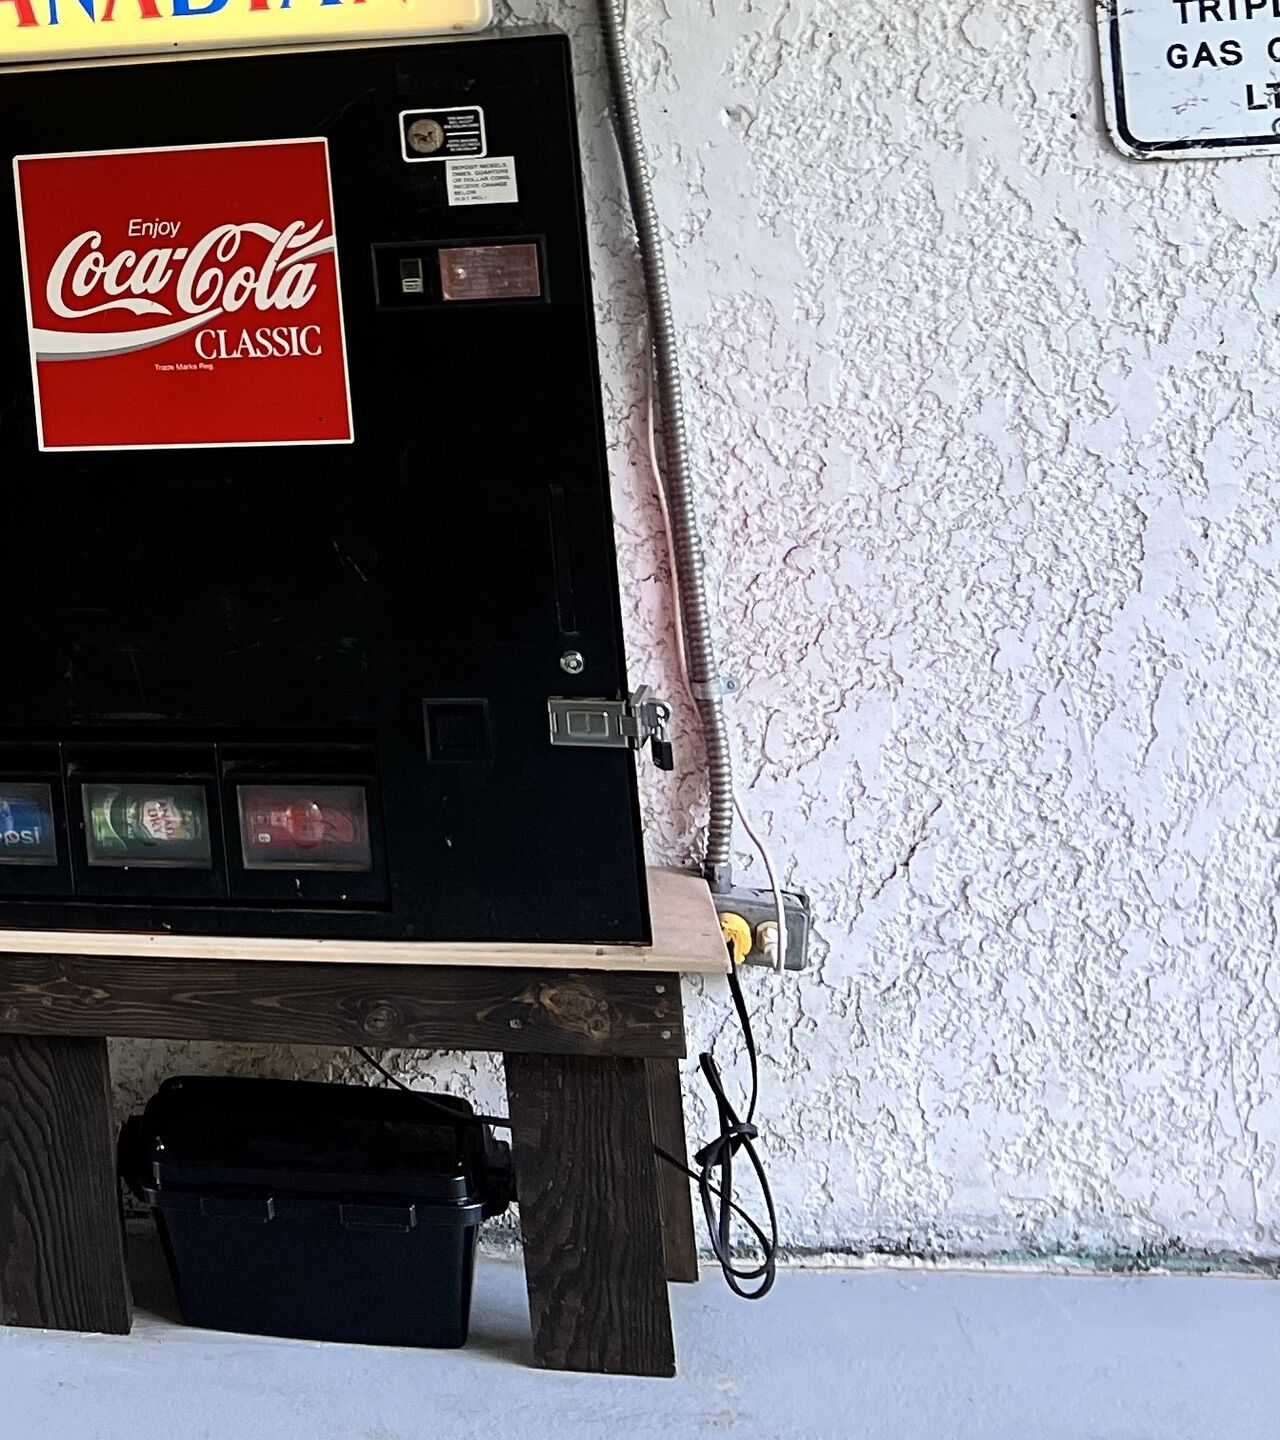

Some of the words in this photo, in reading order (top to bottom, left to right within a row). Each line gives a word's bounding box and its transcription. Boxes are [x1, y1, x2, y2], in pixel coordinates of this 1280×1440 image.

[1167, 39, 1243, 70] GAS
[128, 218, 181, 239] Enjoy
[46, 218, 325, 319] Coca-Cola
[194, 325, 322, 360] CLASSIC
